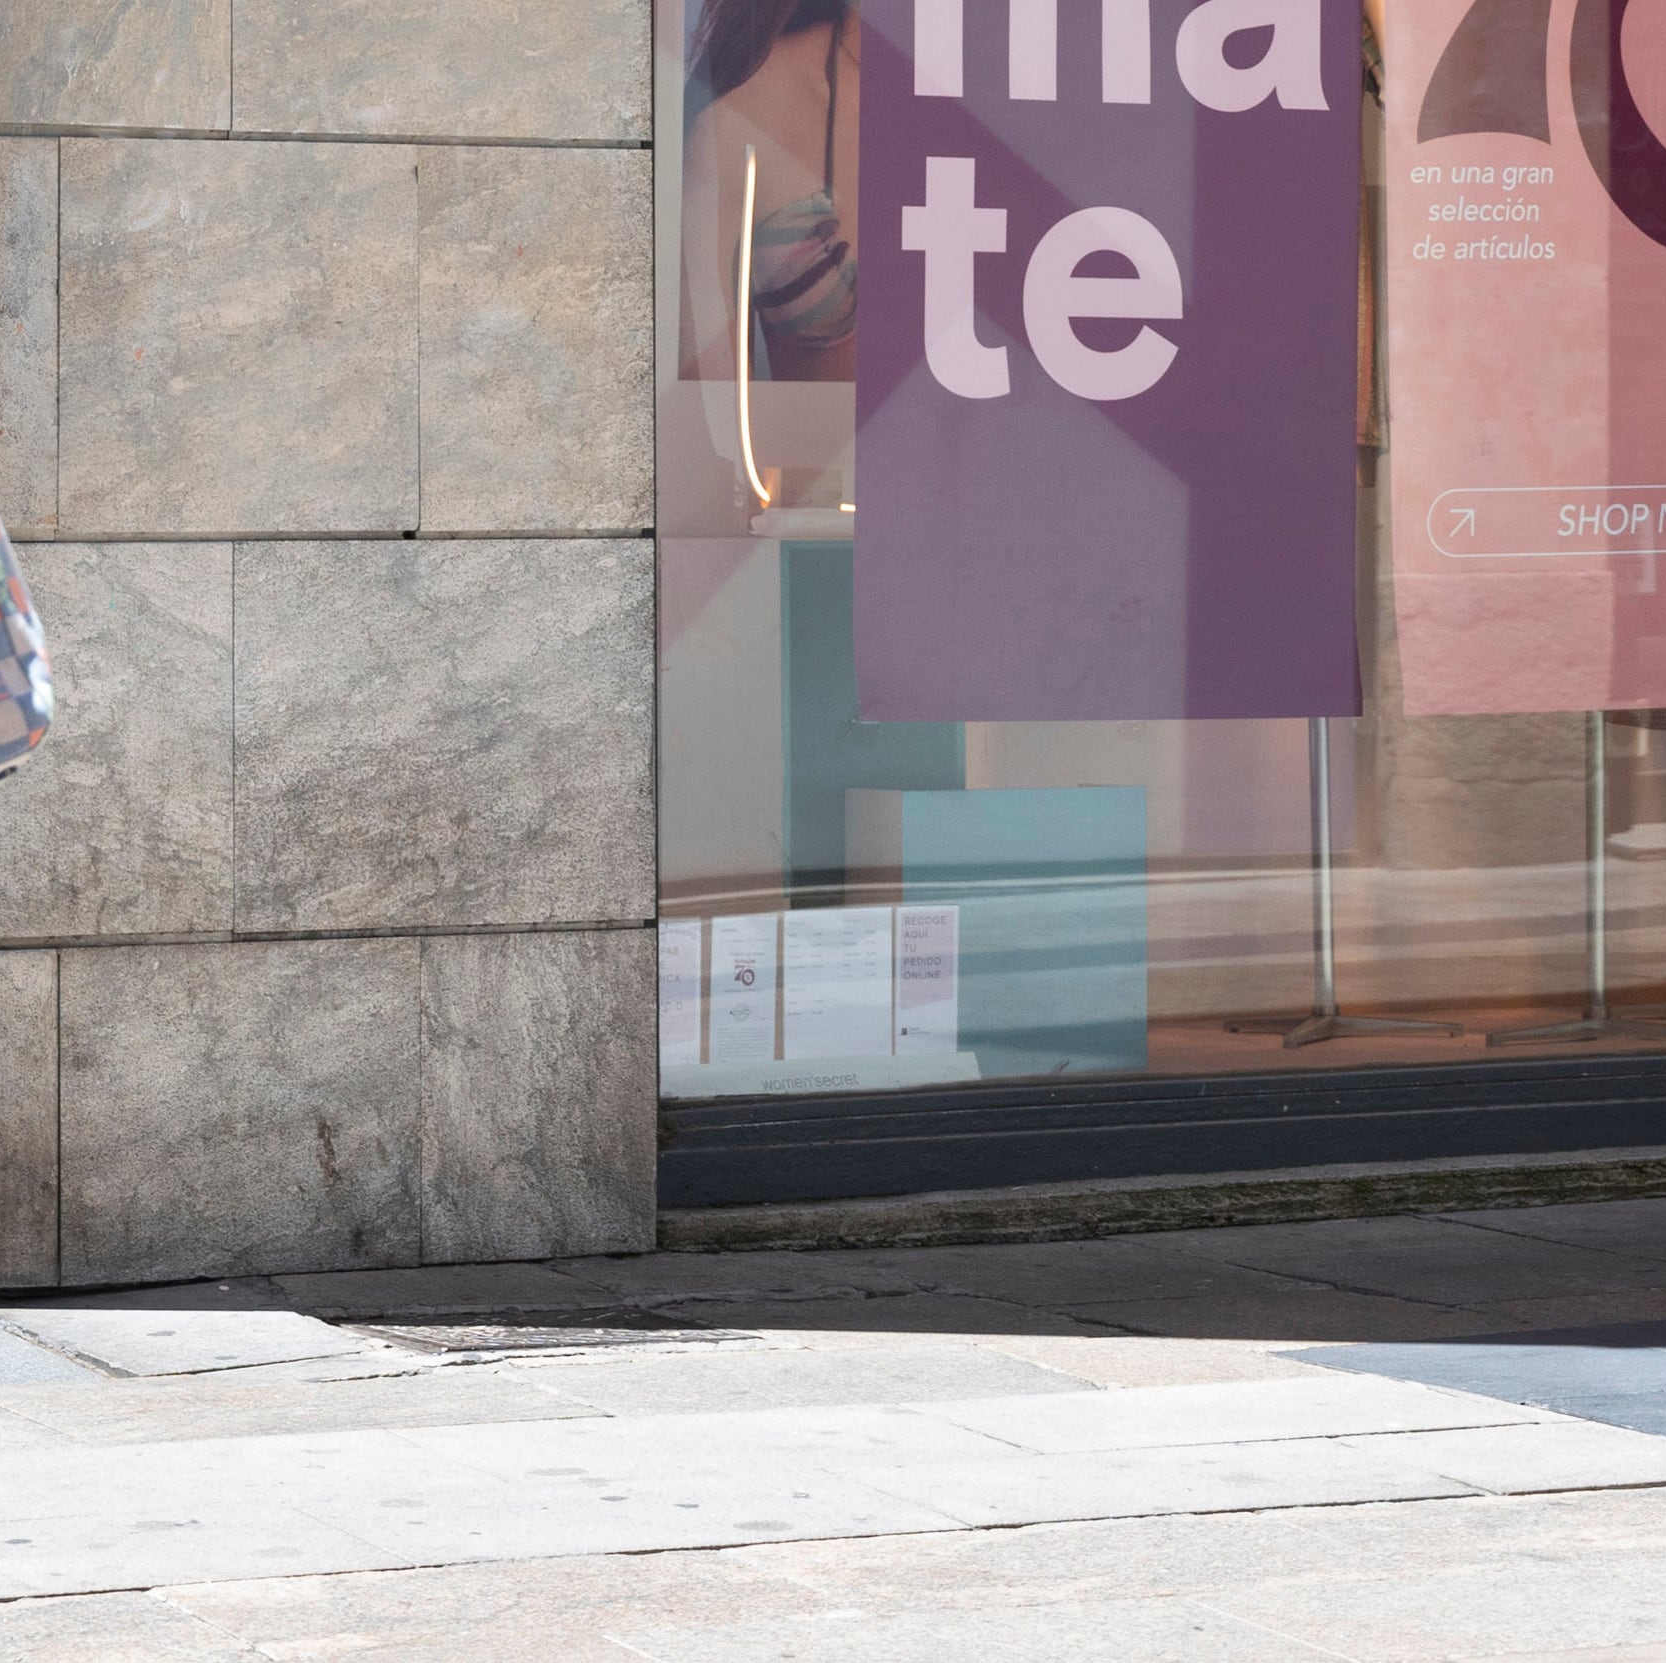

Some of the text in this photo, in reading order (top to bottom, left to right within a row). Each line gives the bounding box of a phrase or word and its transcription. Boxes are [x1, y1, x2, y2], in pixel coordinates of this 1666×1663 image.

[1410, 164, 1554, 193] en una gran
[1428, 195, 1540, 222] selección
[1413, 232, 1556, 261] de artículos
[901, 156, 1184, 401] te
[1557, 502, 1650, 537] SHOP
[903, 957, 942, 967] PEDIDO
[903, 970, 942, 980] ONLINE
